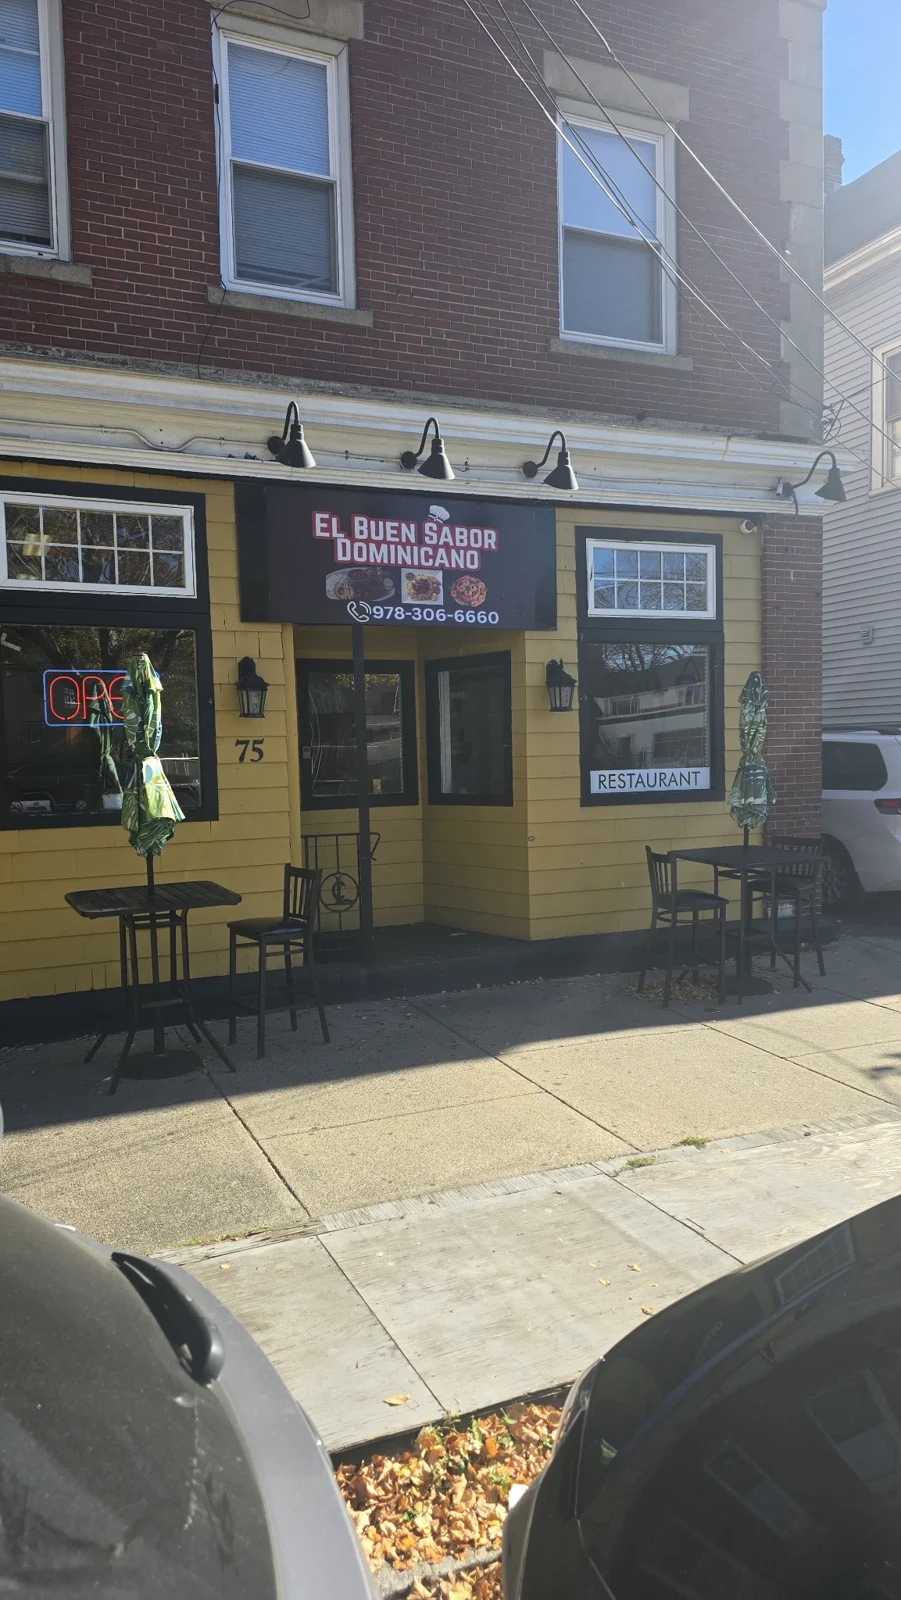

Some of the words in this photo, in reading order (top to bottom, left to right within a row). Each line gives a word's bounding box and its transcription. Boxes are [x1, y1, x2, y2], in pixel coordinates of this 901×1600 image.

[315, 512, 345, 538] EL
[354, 516, 415, 544] BUEN
[424, 522, 496, 550] SABOR
[337, 538, 479, 570] DOMINICANO
[373, 606, 499, 624] 978-306-6660
[49, 675, 126, 720] OPE
[234, 738, 265, 763] 75
[598, 771, 701, 790] RESTAURANT
